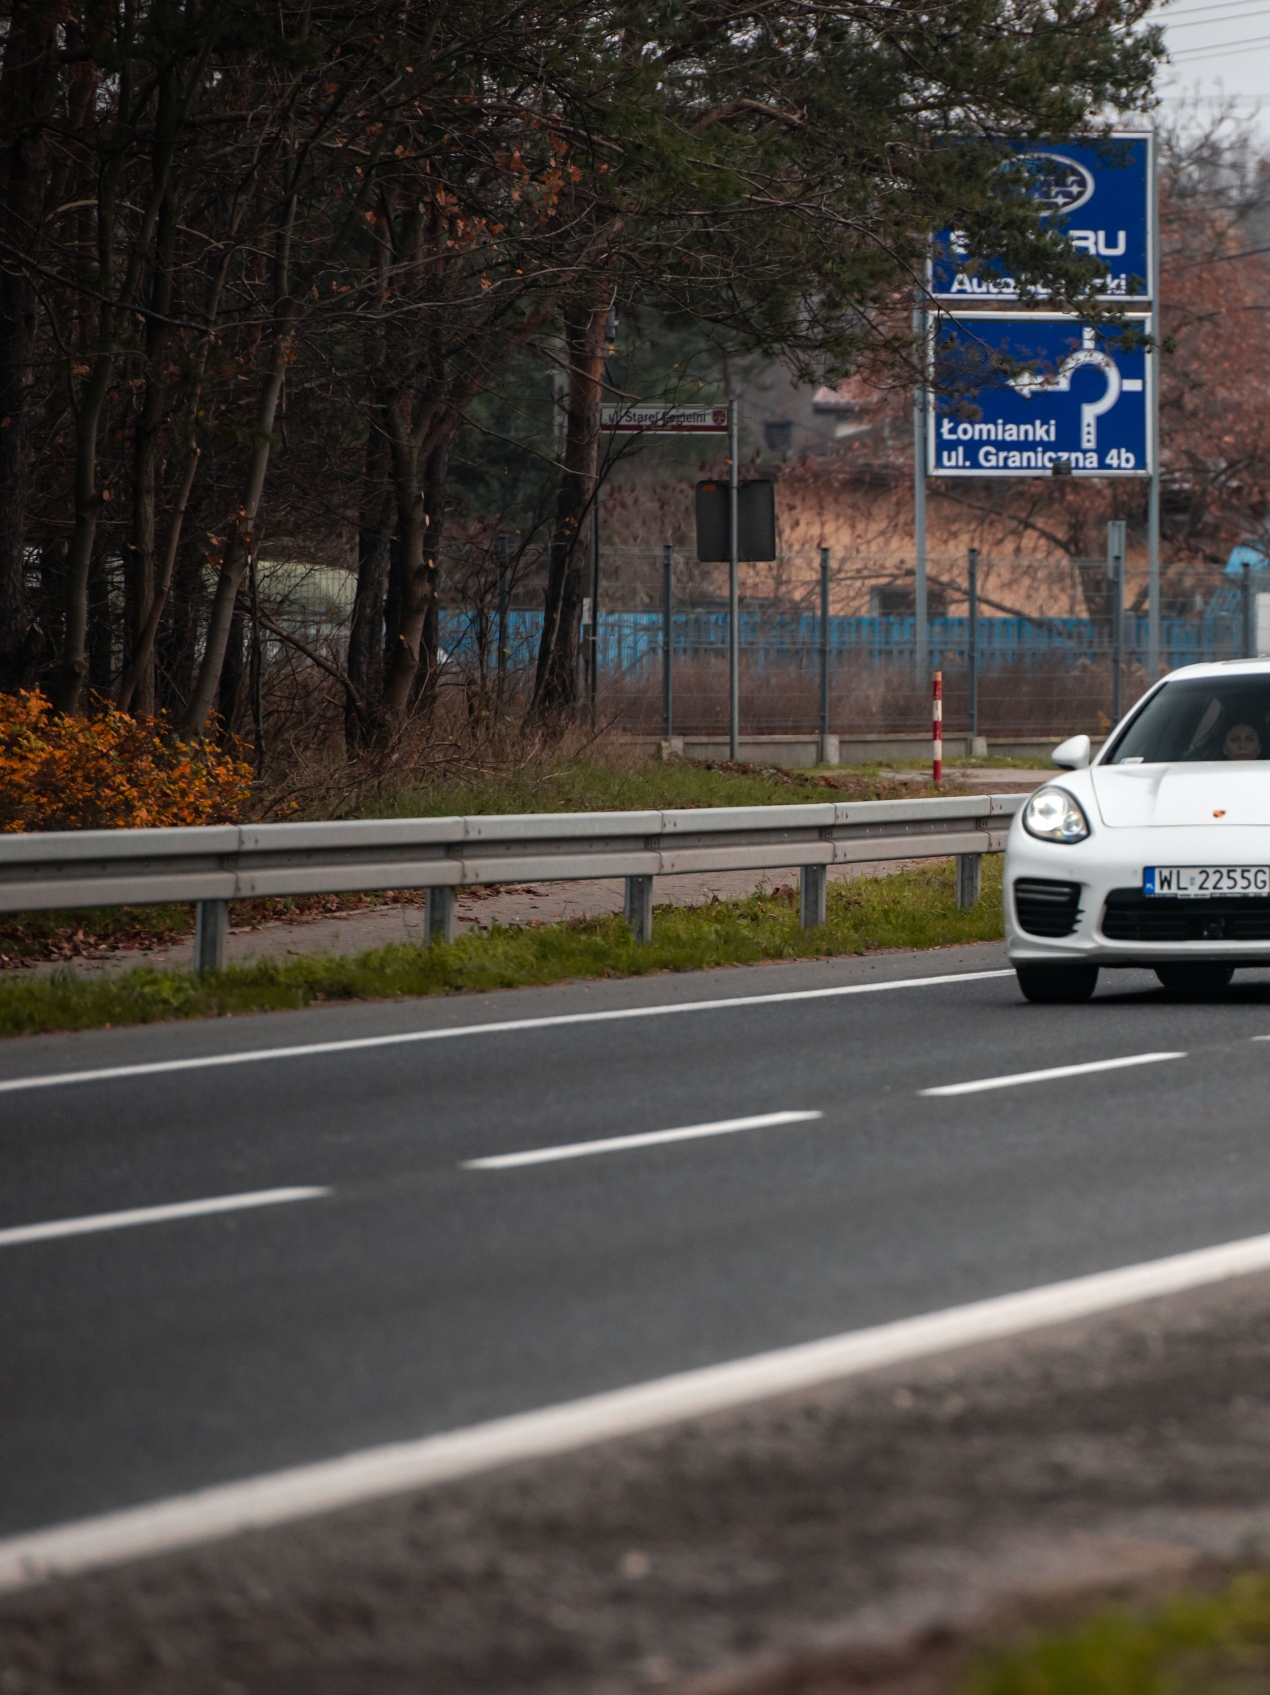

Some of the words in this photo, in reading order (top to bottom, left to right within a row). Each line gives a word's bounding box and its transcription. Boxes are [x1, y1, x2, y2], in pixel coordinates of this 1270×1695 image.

[949, 229, 1126, 256] SRU
[940, 418, 1056, 441] Łomianki
[942, 446, 971, 467] ul.
[978, 446, 1099, 468] Graniczna
[1105, 448, 1136, 468] 4b
[1159, 870, 1188, 890] WL
[1198, 869, 1267, 890] 2255G
